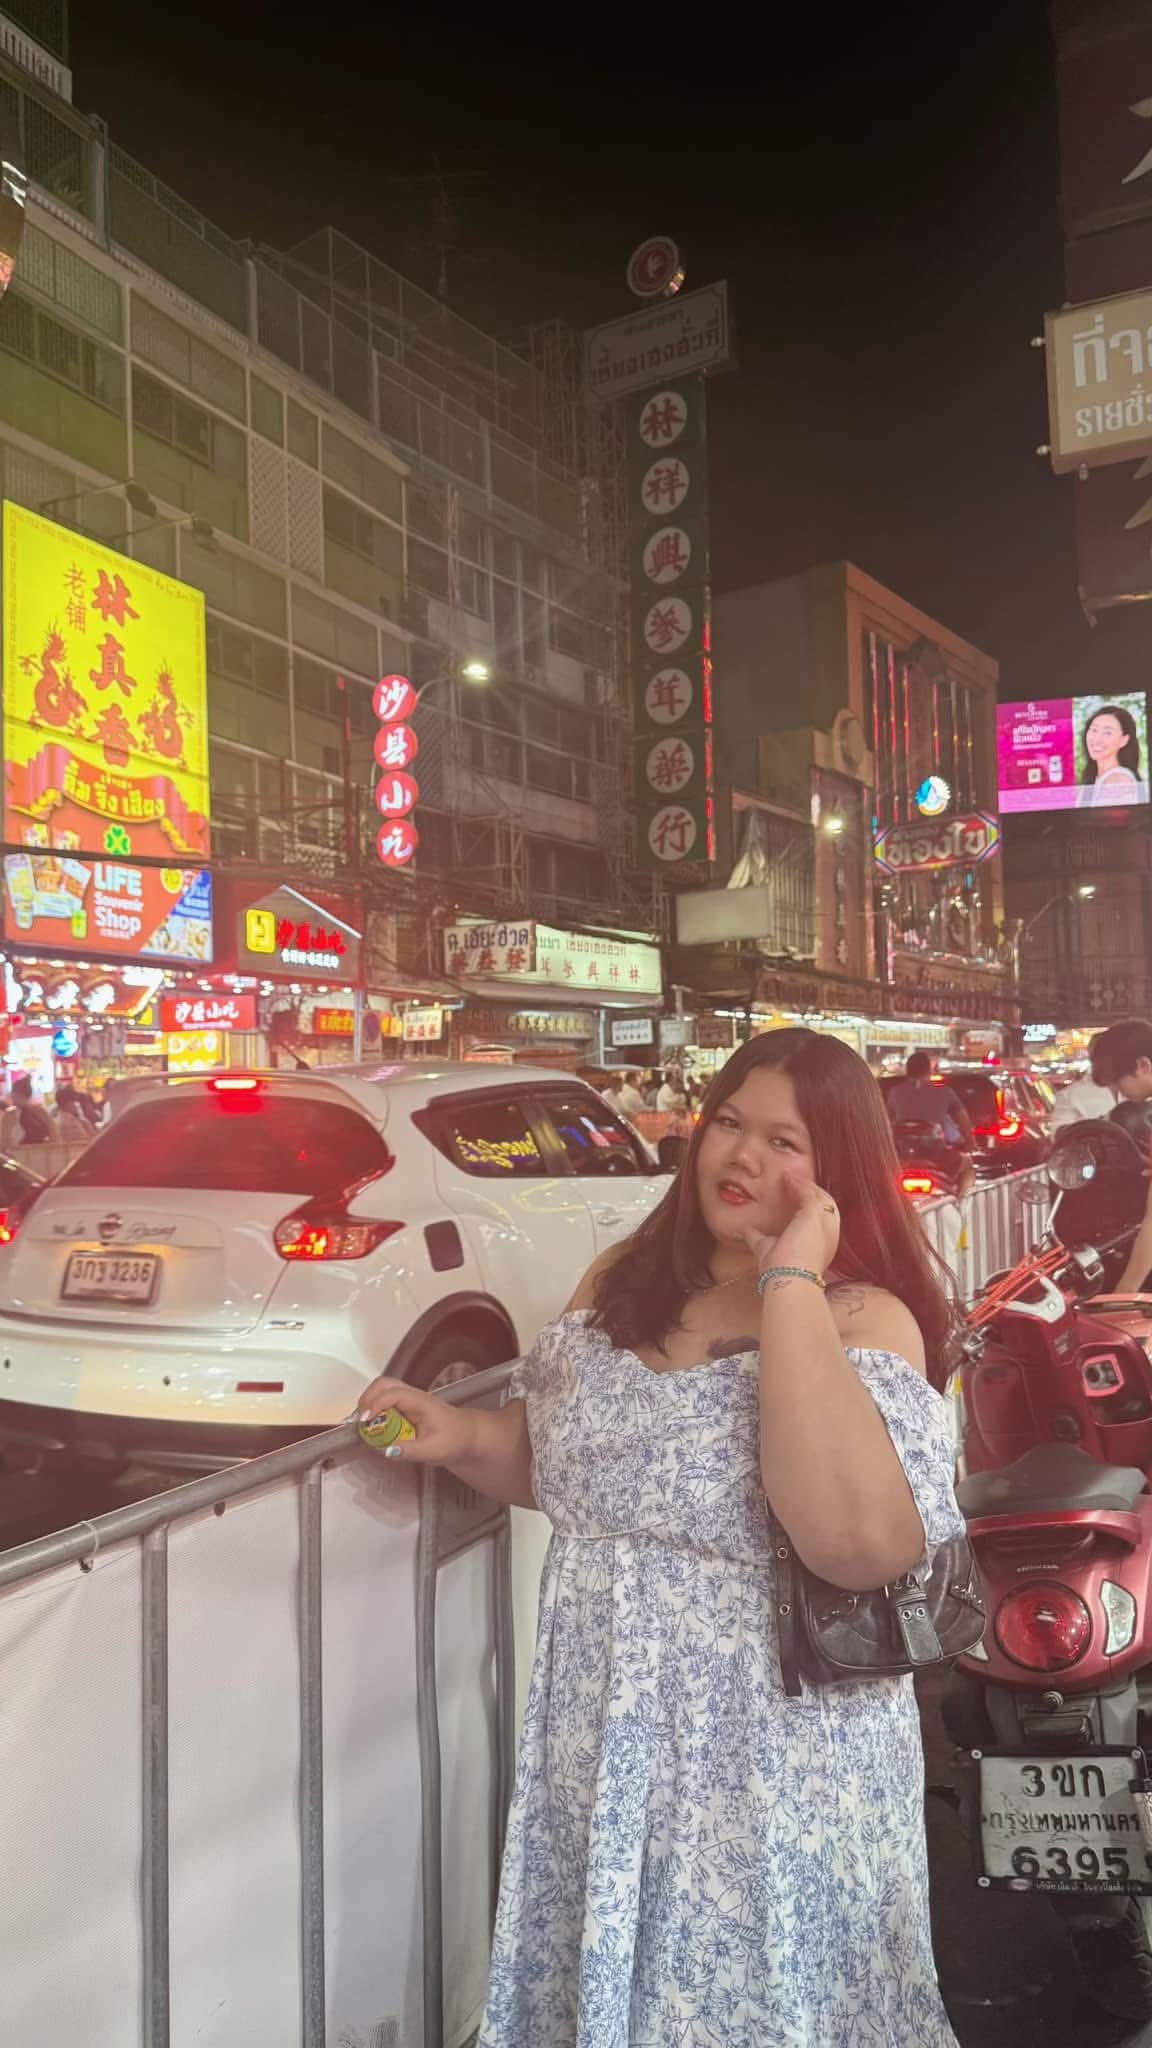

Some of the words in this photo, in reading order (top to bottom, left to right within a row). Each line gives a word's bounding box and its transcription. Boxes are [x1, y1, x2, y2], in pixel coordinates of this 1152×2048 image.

[87, 568, 141, 768] 林真香
[94, 862, 142, 896] LIFE
[95, 906, 142, 936] Shop
[1021, 1764, 1106, 1798] 3ขก
[989, 1812, 1141, 1836] กรุงเทพมหานคร
[1011, 1846, 1131, 1880] 6395
